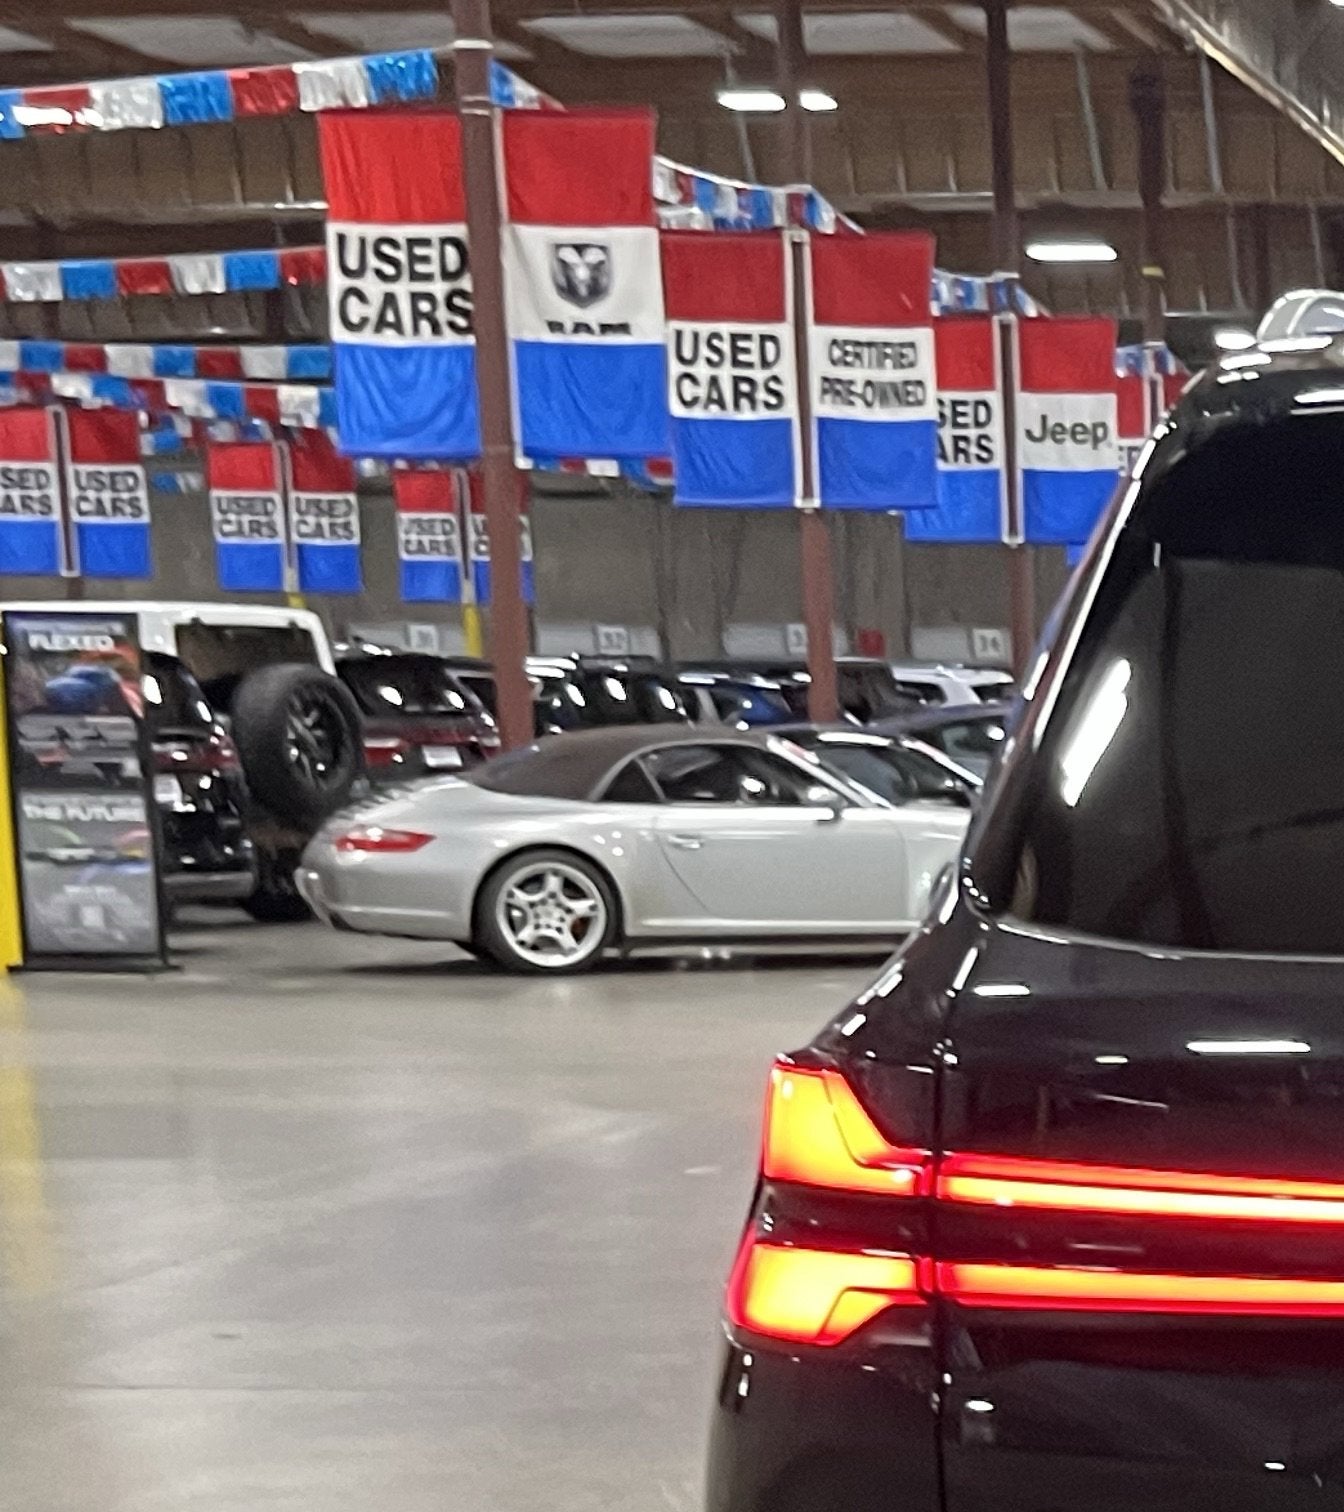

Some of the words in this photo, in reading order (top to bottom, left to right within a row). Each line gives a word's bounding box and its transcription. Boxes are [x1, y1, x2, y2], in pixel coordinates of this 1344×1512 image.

[336, 233, 469, 283] USED
[338, 287, 474, 336] CARS
[674, 329, 781, 370] USED
[829, 338, 918, 368] CERTIFIED
[675, 372, 785, 412] CARS
[820, 376, 927, 408] PRE-OWNED
[937, 398, 992, 429] SED
[1025, 414, 1110, 450] Jeep
[0, 467, 50, 490] SED
[74, 469, 140, 492] USED
[0, 494, 52, 515] ARS
[75, 495, 142, 518] CARS
[216, 496, 277, 515] USED
[219, 518, 278, 538] CARS
